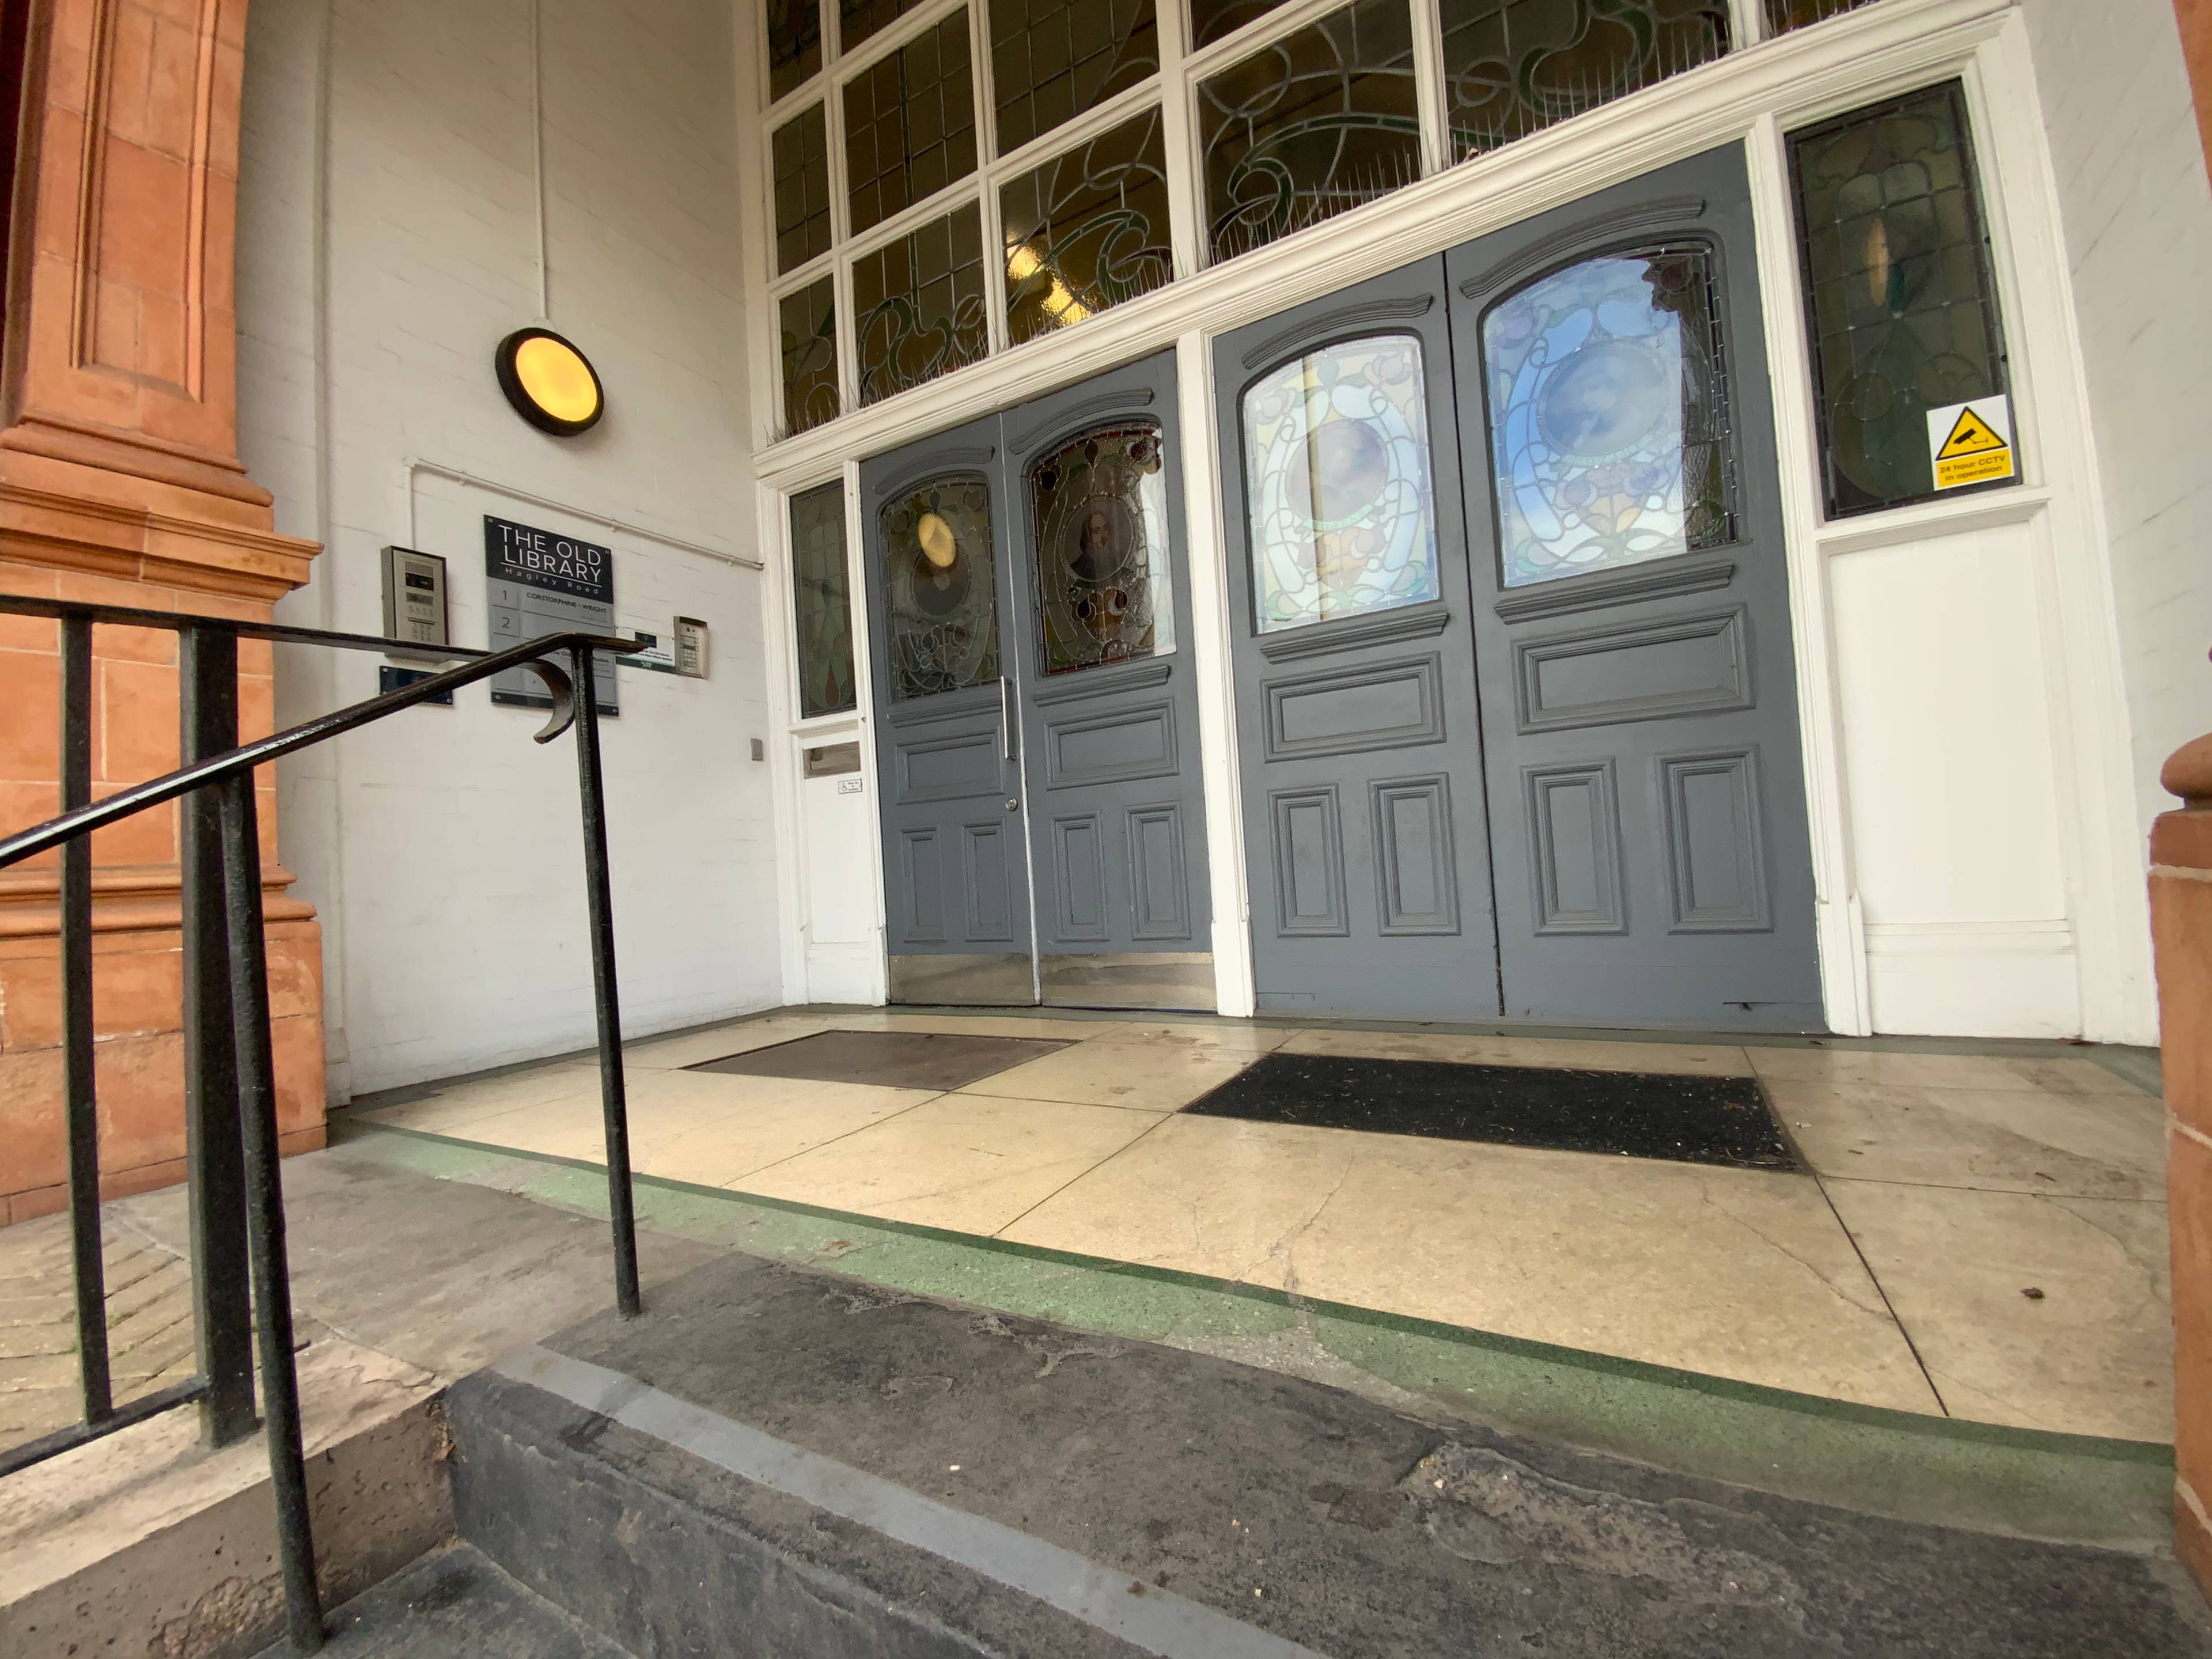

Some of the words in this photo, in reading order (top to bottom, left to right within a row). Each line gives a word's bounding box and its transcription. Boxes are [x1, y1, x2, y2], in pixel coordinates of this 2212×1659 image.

[1940, 465, 1951, 474] 24
[1953, 460, 1976, 472] hour
[1978, 454, 2006, 465] CCTV
[1956, 465, 2002, 479] operation
[498, 525, 546, 553] THE
[556, 541, 601, 566] OLD
[504, 545, 601, 583] LIBRARY
[505, 567, 557, 585] Hagley
[567, 582, 599, 594] Road
[502, 590, 507, 601] 1
[527, 592, 577, 608] CORSTORPHINE
[582, 604, 607, 614] WRIGHT
[502, 617, 510, 629] 2
